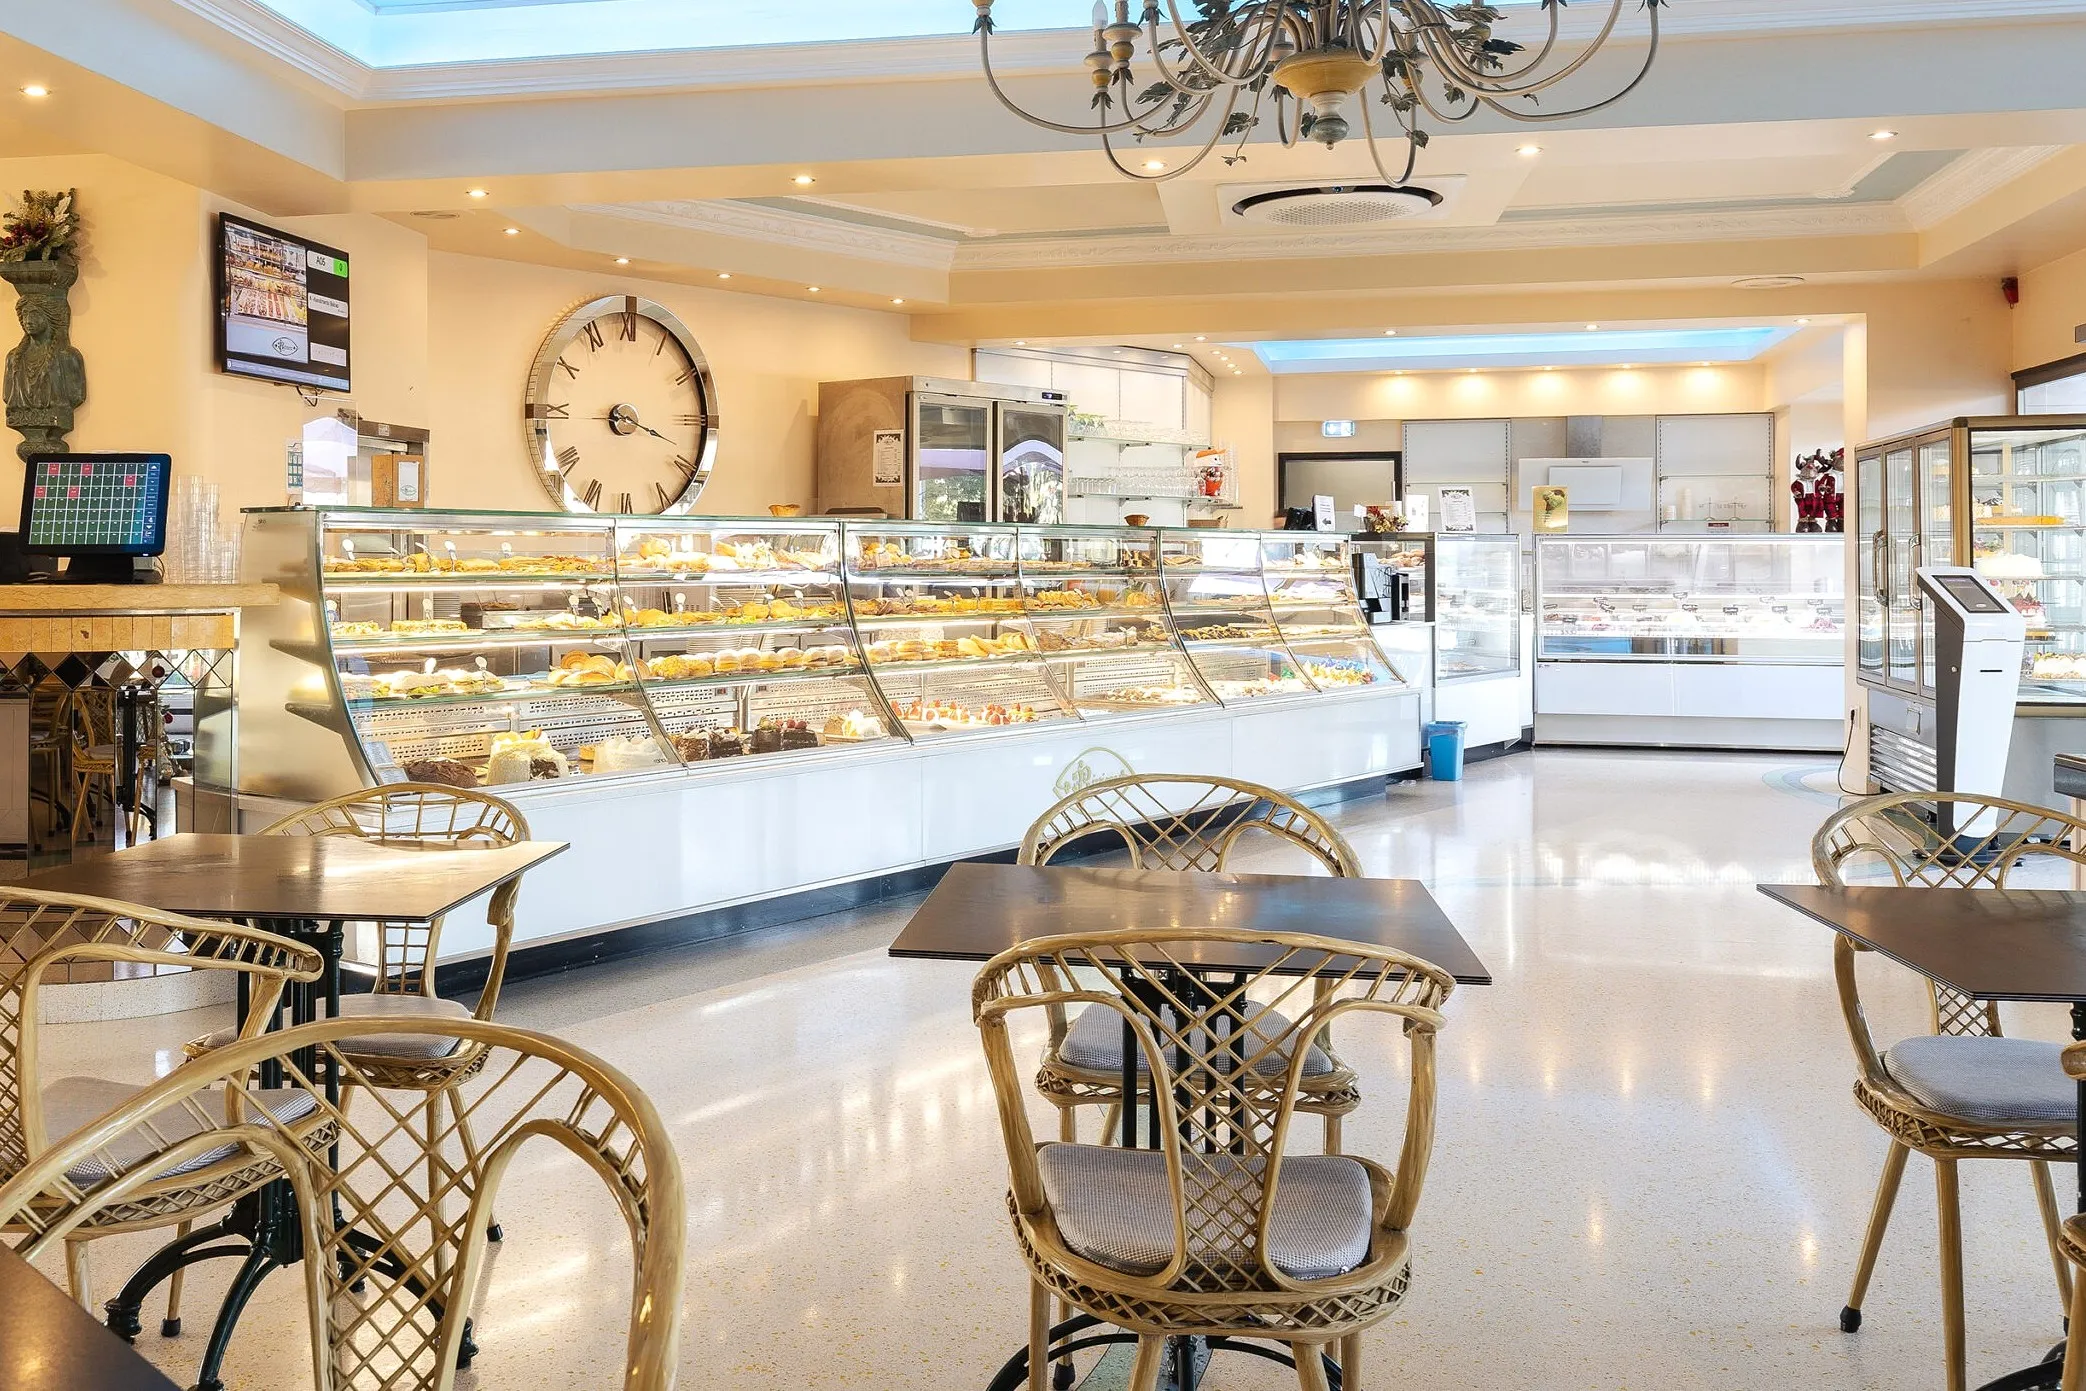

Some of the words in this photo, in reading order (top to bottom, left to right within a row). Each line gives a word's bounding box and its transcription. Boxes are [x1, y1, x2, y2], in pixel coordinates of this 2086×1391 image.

[583, 320, 604, 352] XI
[619, 312, 637, 342] XII
[557, 356, 580, 380] X
[675, 367, 698, 386] II
[547, 403, 569, 420] IX
[674, 454, 697, 479] IV
